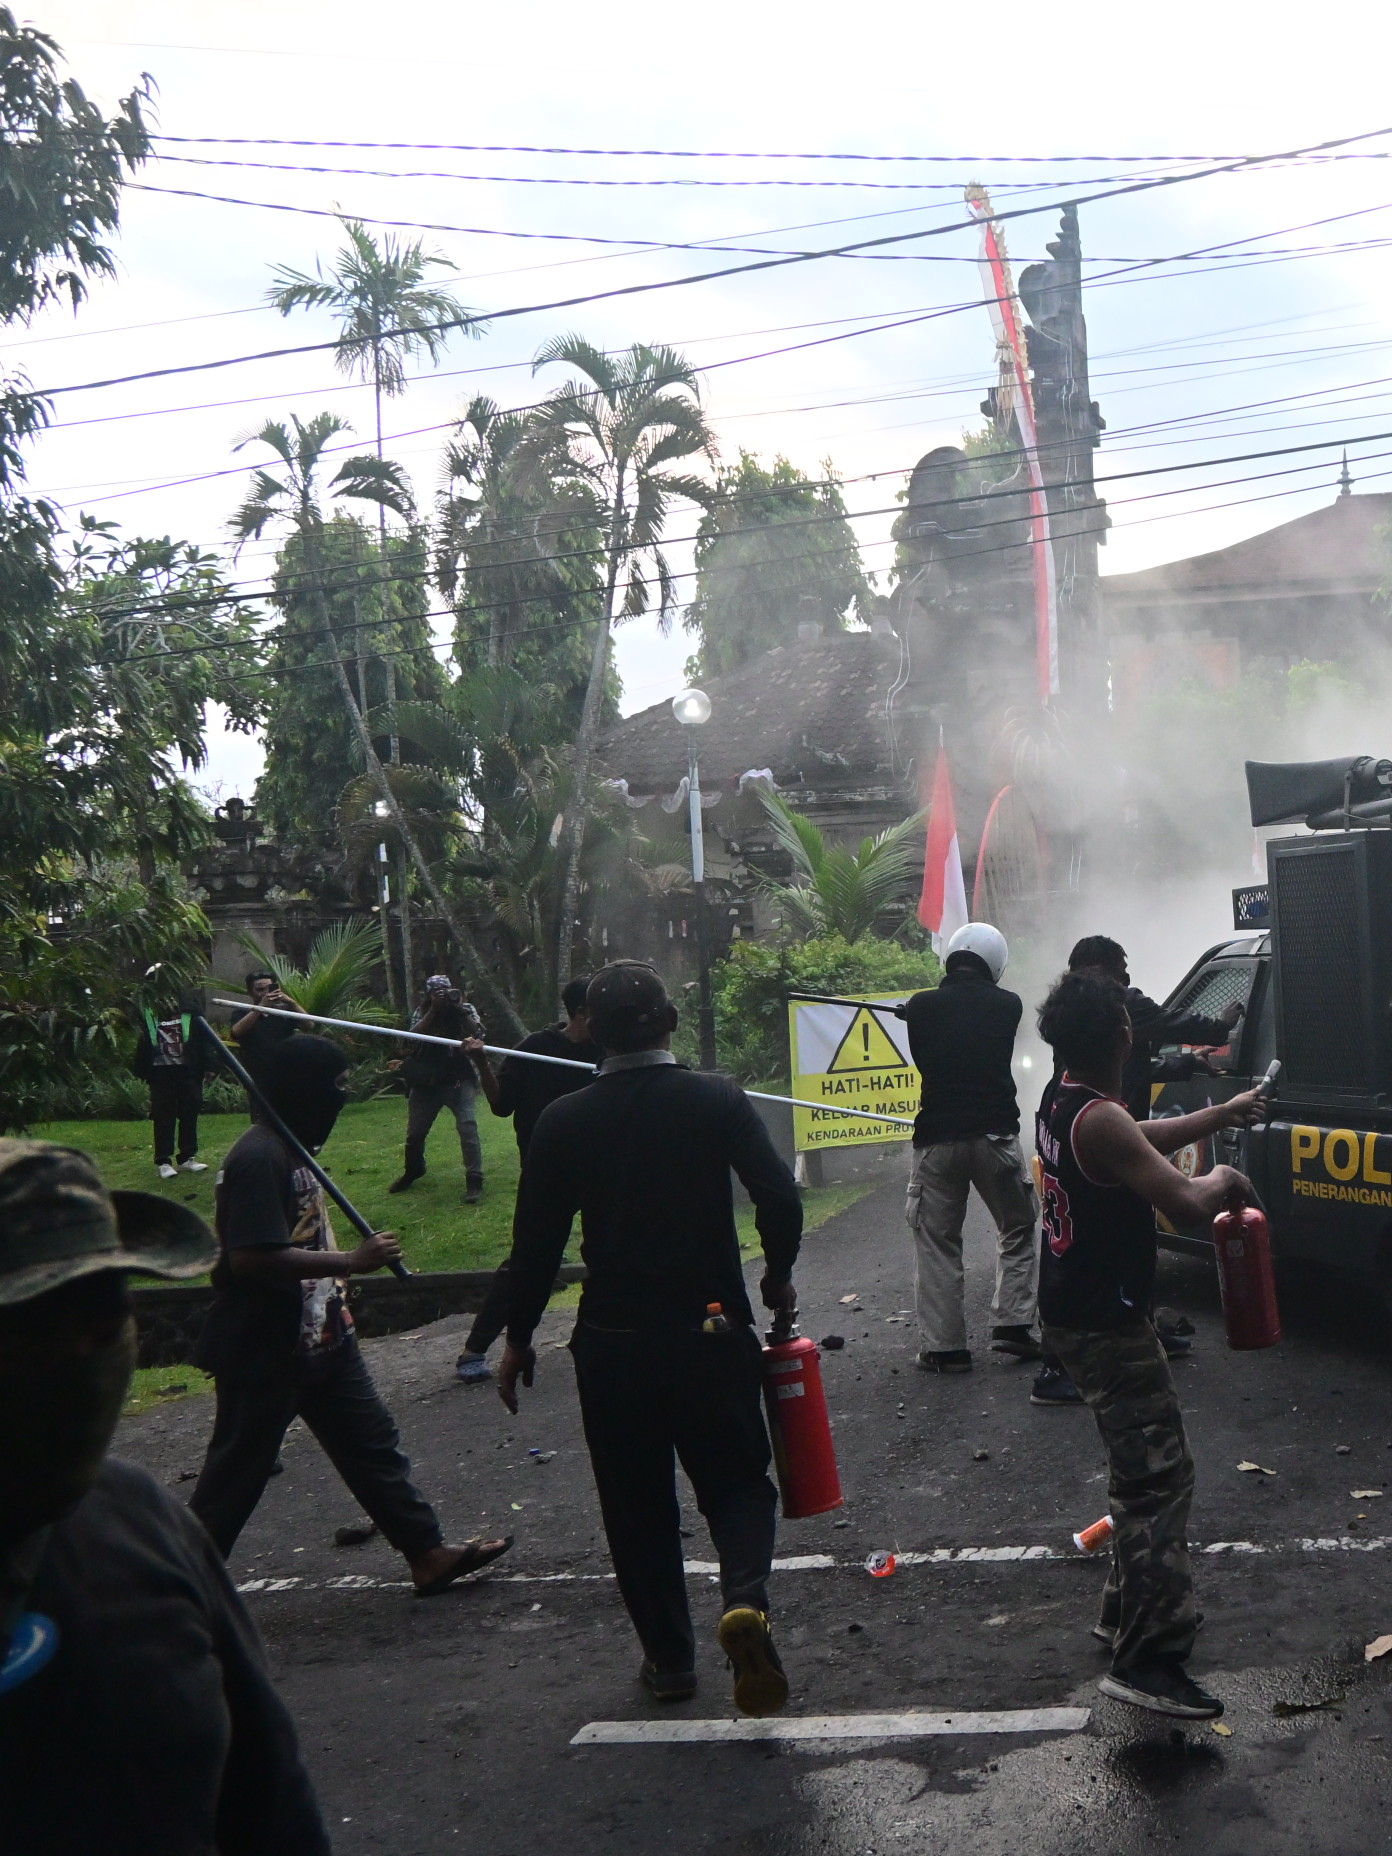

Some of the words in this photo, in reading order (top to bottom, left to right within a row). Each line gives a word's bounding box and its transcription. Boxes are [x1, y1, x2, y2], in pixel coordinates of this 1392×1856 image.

[821, 1073, 914, 1096] HATI-HATI!
[876, 1099, 922, 1115] MASU
[807, 1125, 882, 1142] KENDARAAN
[1292, 1178, 1392, 1208] PENERANGAN
